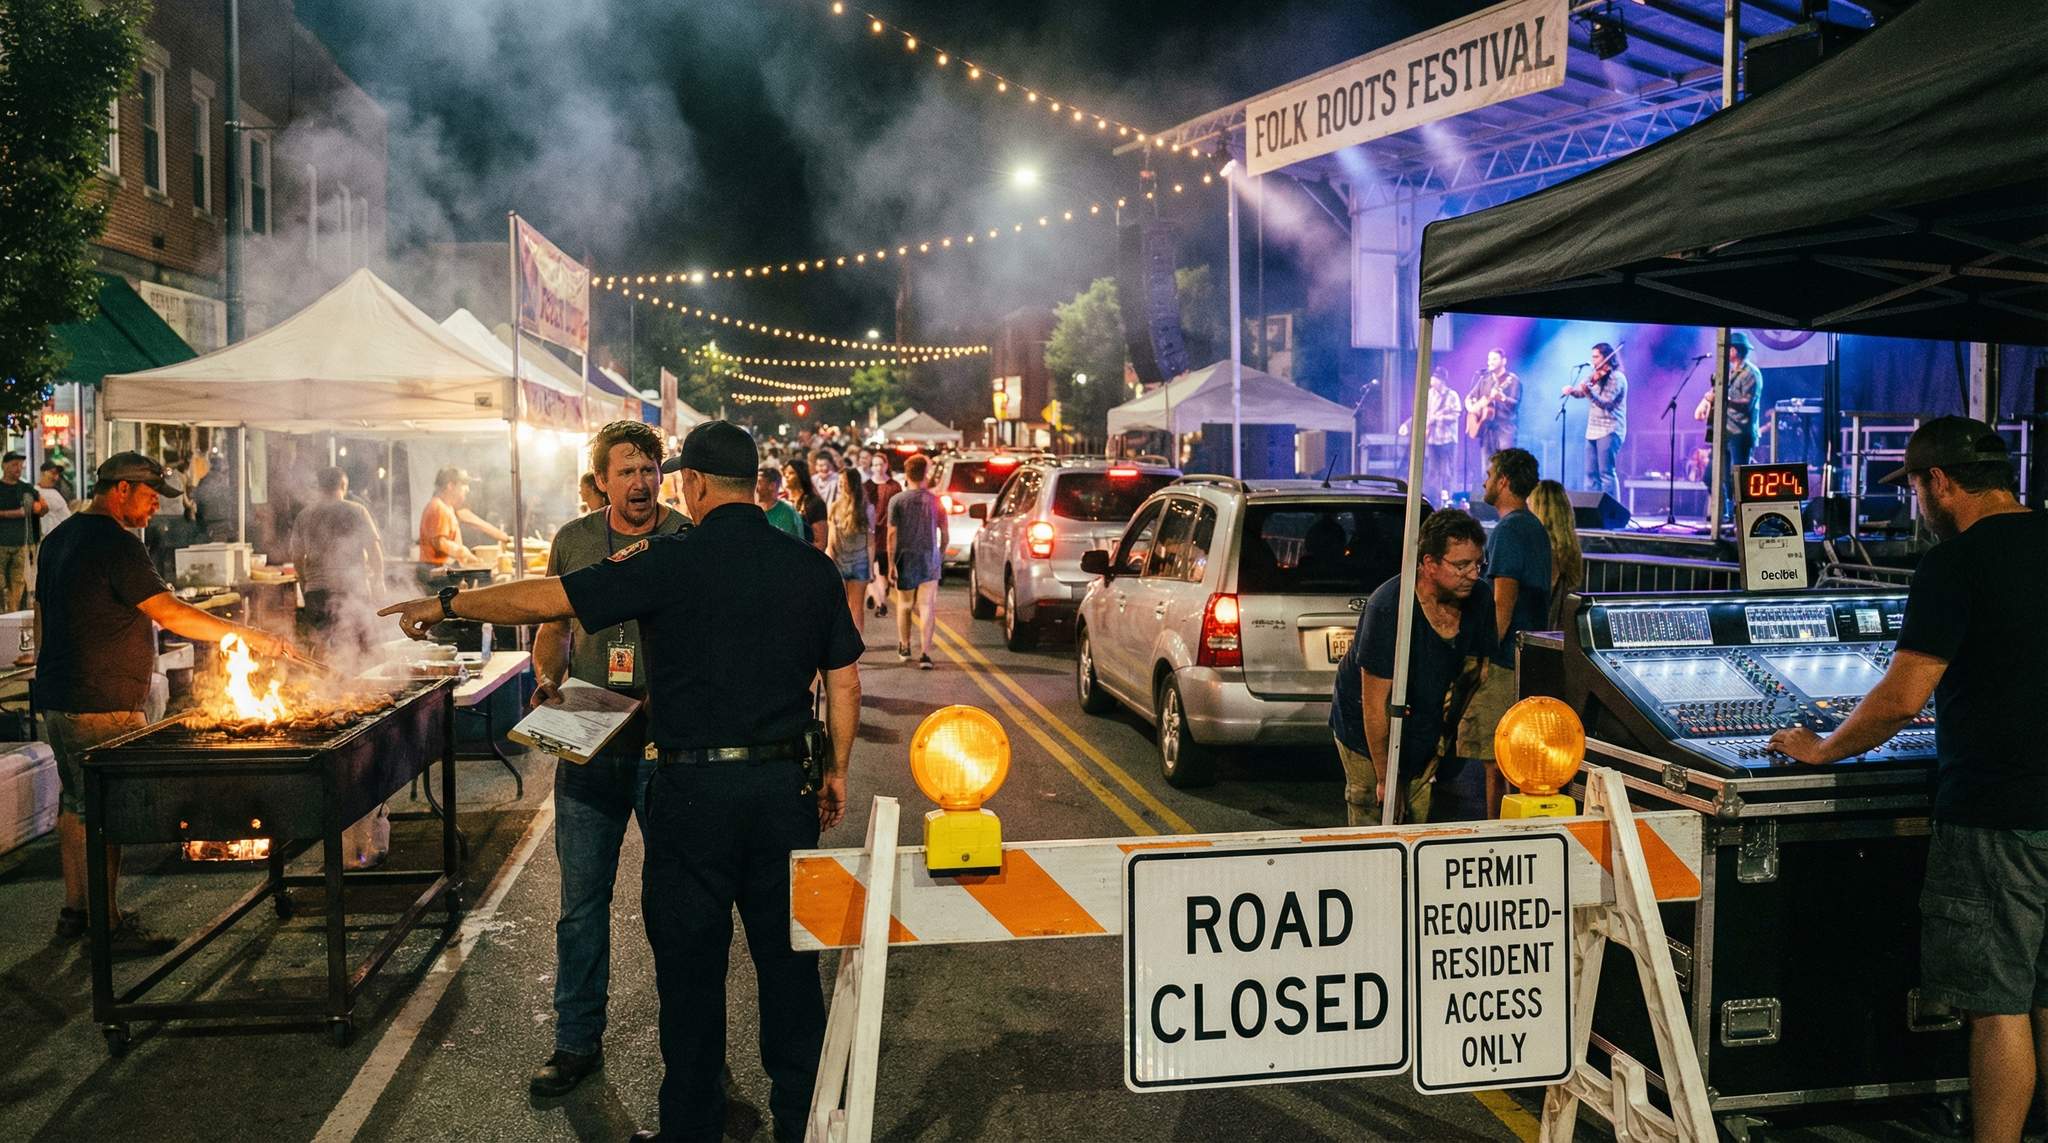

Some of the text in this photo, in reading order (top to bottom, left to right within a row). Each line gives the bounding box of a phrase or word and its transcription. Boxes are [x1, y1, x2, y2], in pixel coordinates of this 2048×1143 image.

[1255, 15, 1556, 157] FOLK ROOTS FESTIVAL
[1445, 853, 1538, 890] PERMIT
[1186, 888, 1354, 954] ROAD
[1424, 897, 1563, 936] REQUIRED-
[1431, 941, 1555, 980] RESIDENT
[1150, 971, 1389, 1044] CLOSED
[1445, 987, 1543, 1025] ACCESS
[1461, 1032, 1527, 1067] ONLY
